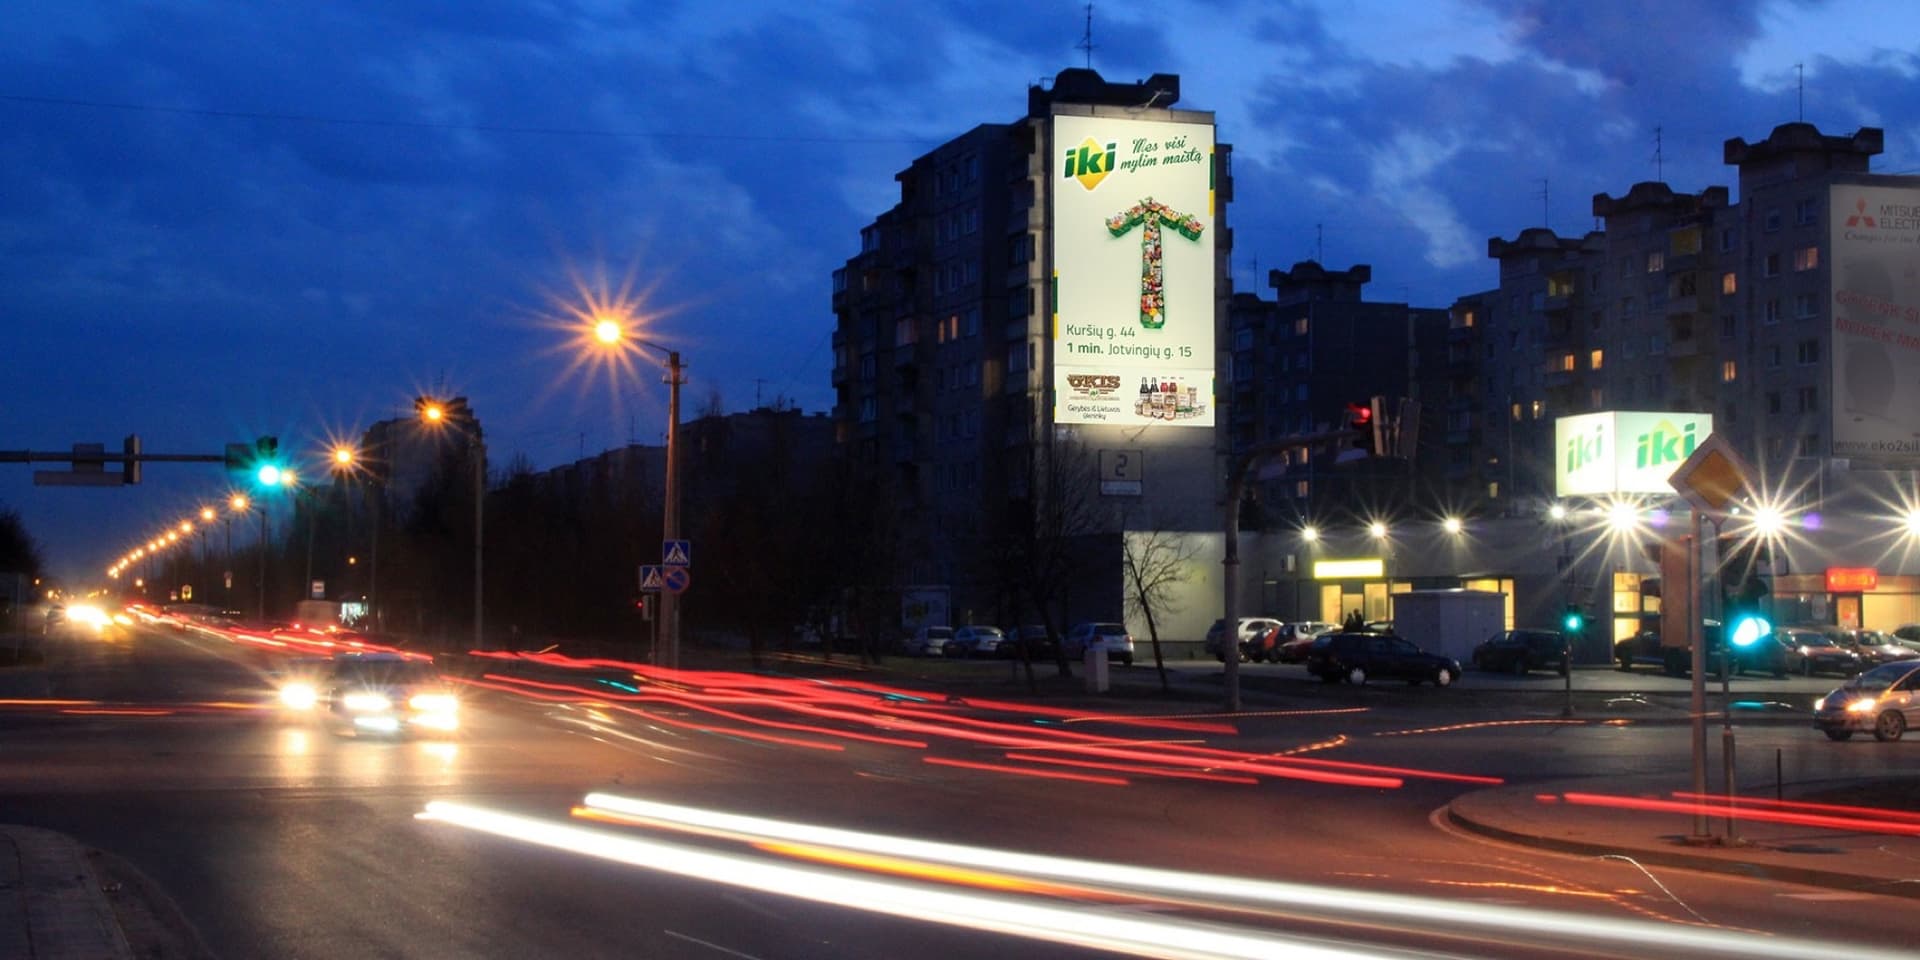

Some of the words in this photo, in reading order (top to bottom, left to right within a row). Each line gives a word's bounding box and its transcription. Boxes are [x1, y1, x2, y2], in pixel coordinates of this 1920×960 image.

[1132, 137, 1158, 154] Mes
[1164, 135, 1188, 150] visi
[1064, 142, 1117, 178] iki
[1120, 156, 1157, 173] mylim
[1163, 148, 1203, 164] maistą
[1066, 324, 1103, 339] Kuršių
[1106, 328, 1117, 340] g.
[1120, 326, 1135, 337] 44
[1067, 342, 1073, 353] 1
[1078, 342, 1104, 354] min.
[1108, 343, 1160, 358] Jotvingių
[1164, 347, 1174, 360] g.
[1180, 346, 1192, 358] 15
[1567, 423, 1603, 474] iki
[1636, 422, 1696, 469] iki
[1115, 454, 1128, 477] 2
